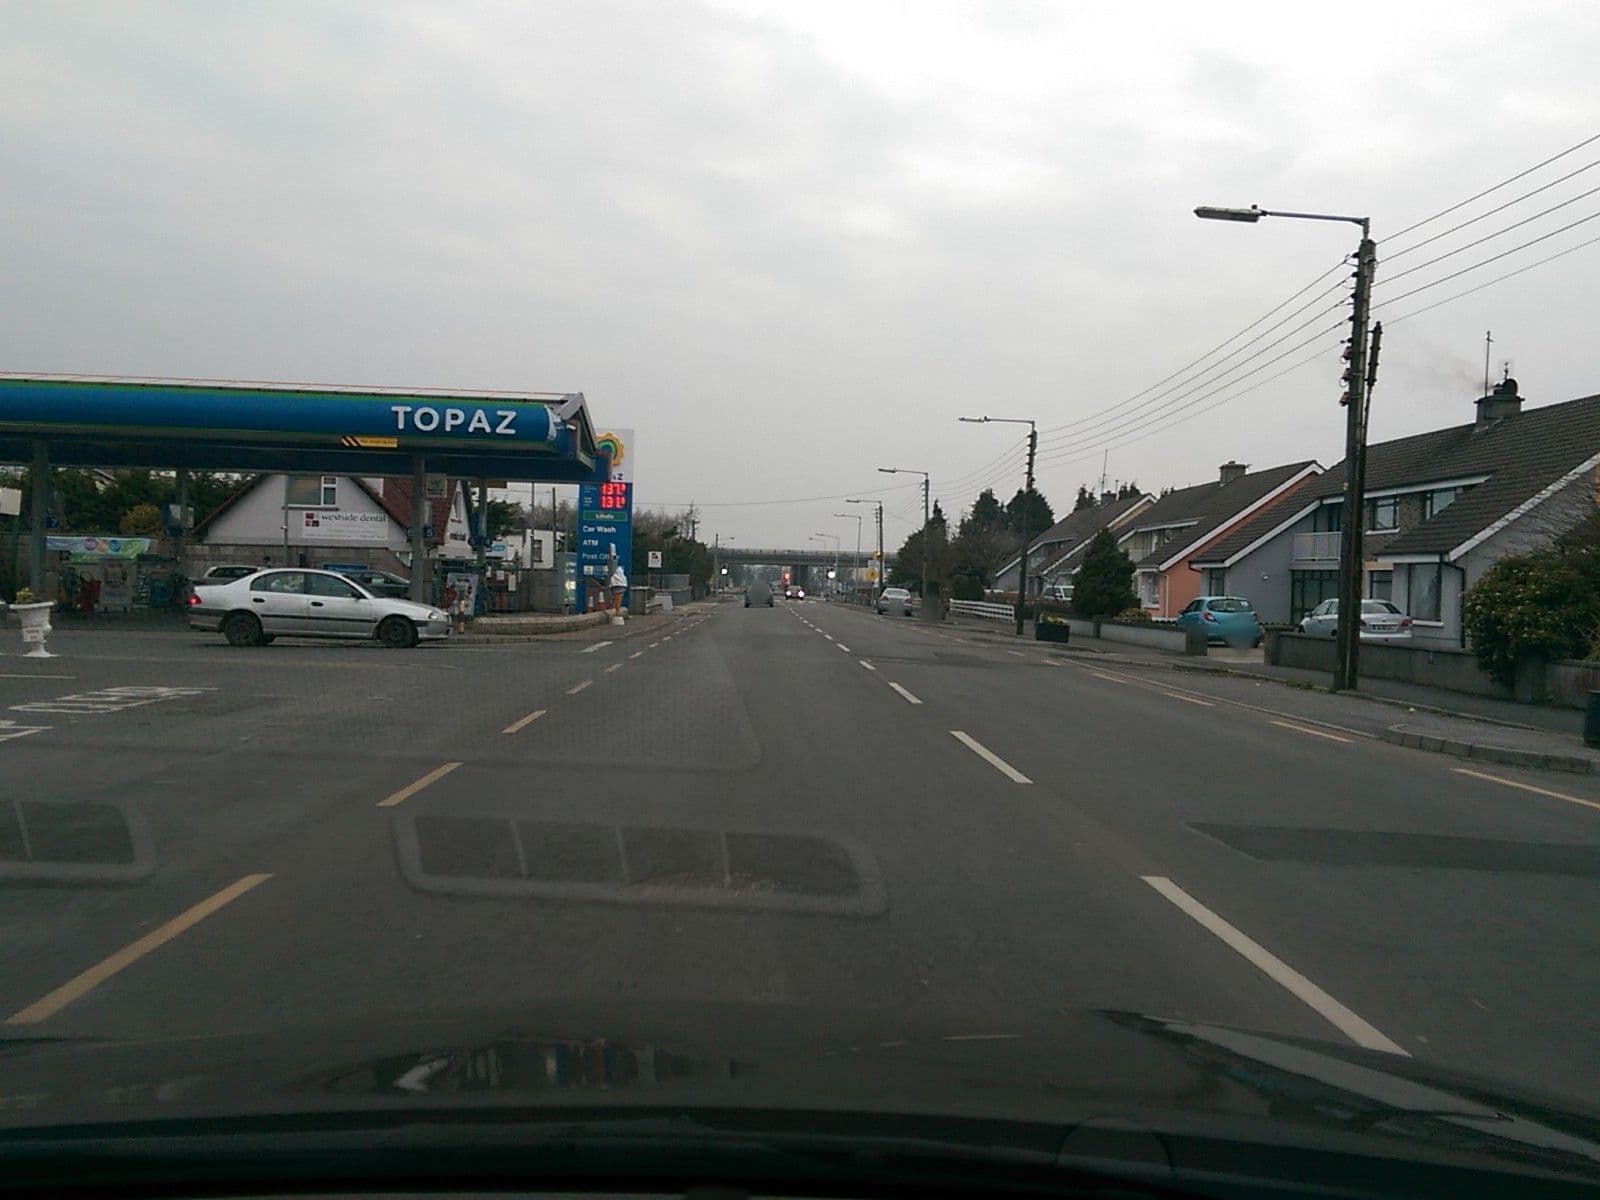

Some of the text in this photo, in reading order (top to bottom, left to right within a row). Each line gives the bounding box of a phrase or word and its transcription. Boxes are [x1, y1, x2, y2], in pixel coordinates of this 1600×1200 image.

[391, 405, 517, 435] TOPAZ
[321, 513, 386, 522] westside dental
